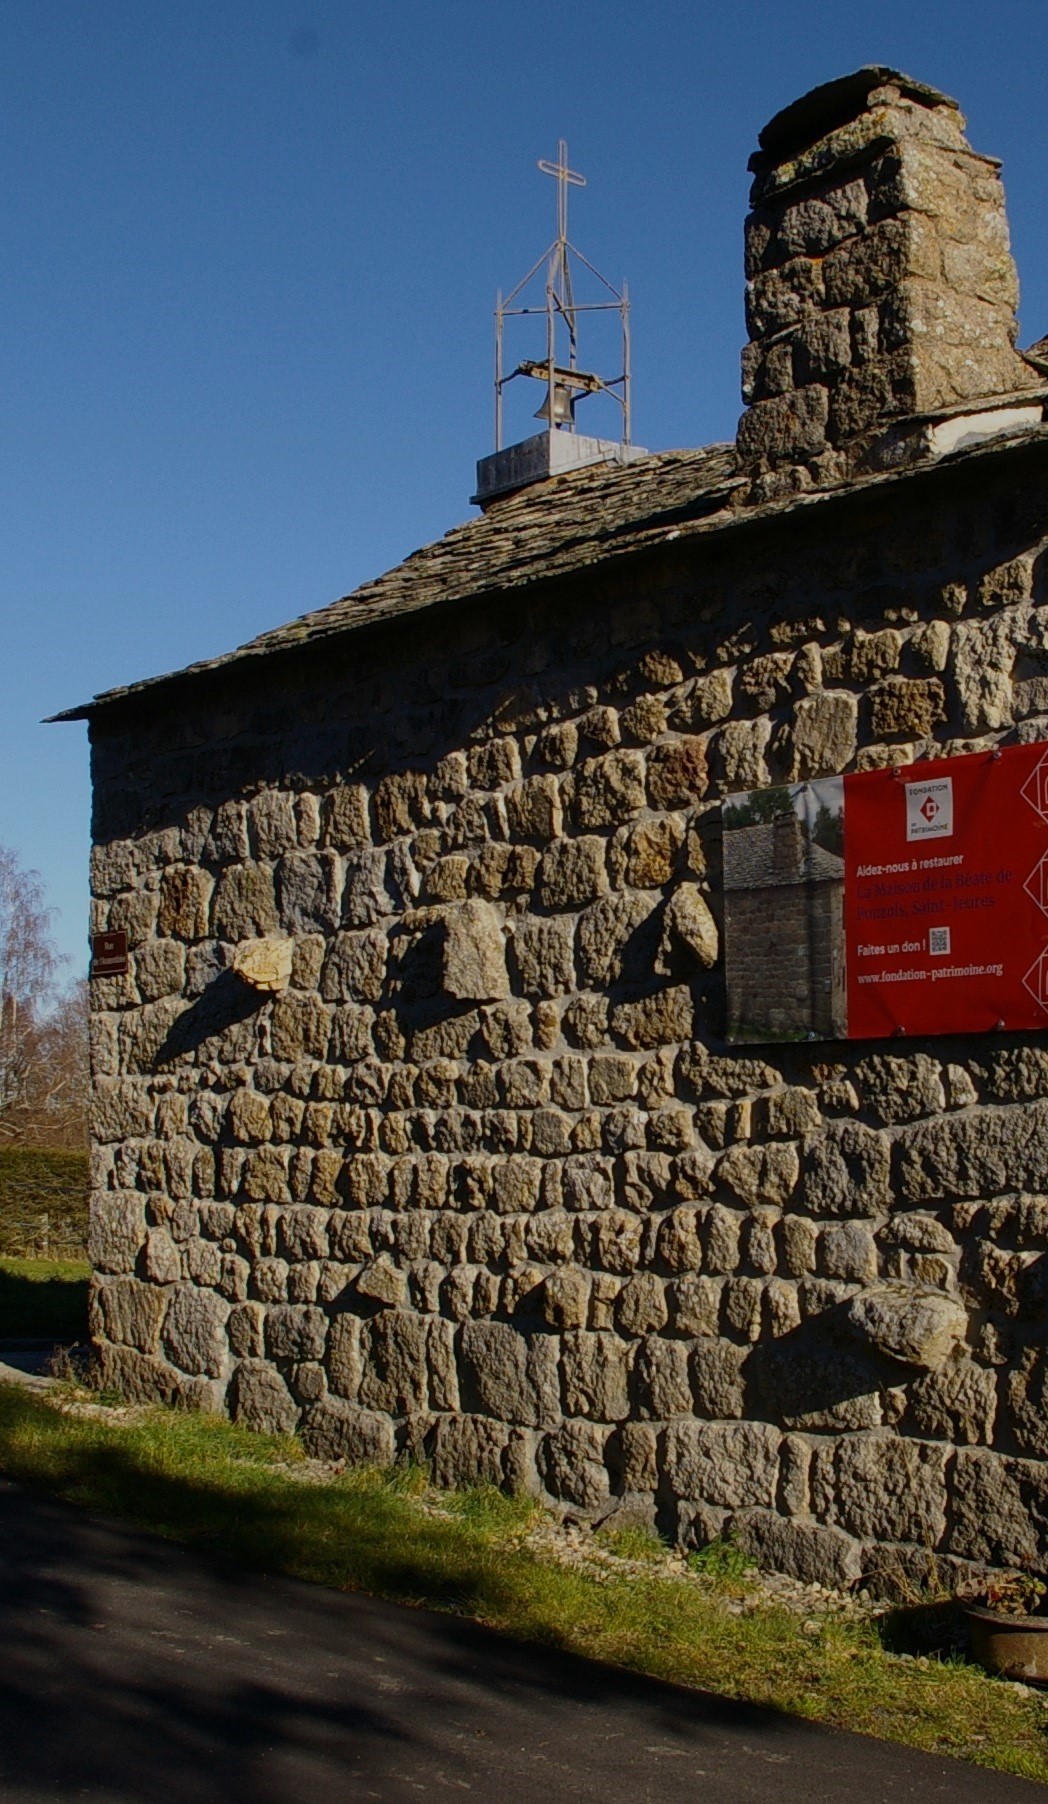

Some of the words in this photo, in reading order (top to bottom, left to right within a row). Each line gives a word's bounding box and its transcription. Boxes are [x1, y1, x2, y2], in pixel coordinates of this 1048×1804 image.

[909, 784, 948, 795] FONDATION
[856, 862, 910, 877] Aidez-nous
[911, 858, 917, 870] à
[919, 855, 964, 869] restaurer
[874, 882, 920, 897] Maison
[923, 875, 938, 891] de
[941, 874, 952, 889] la
[995, 868, 1012, 883] de
[857, 944, 885, 956] Faites
[887, 944, 900, 954] un
[901, 940, 920, 952] don
[858, 963, 1003, 984] www.fondation-patrimoine.org
